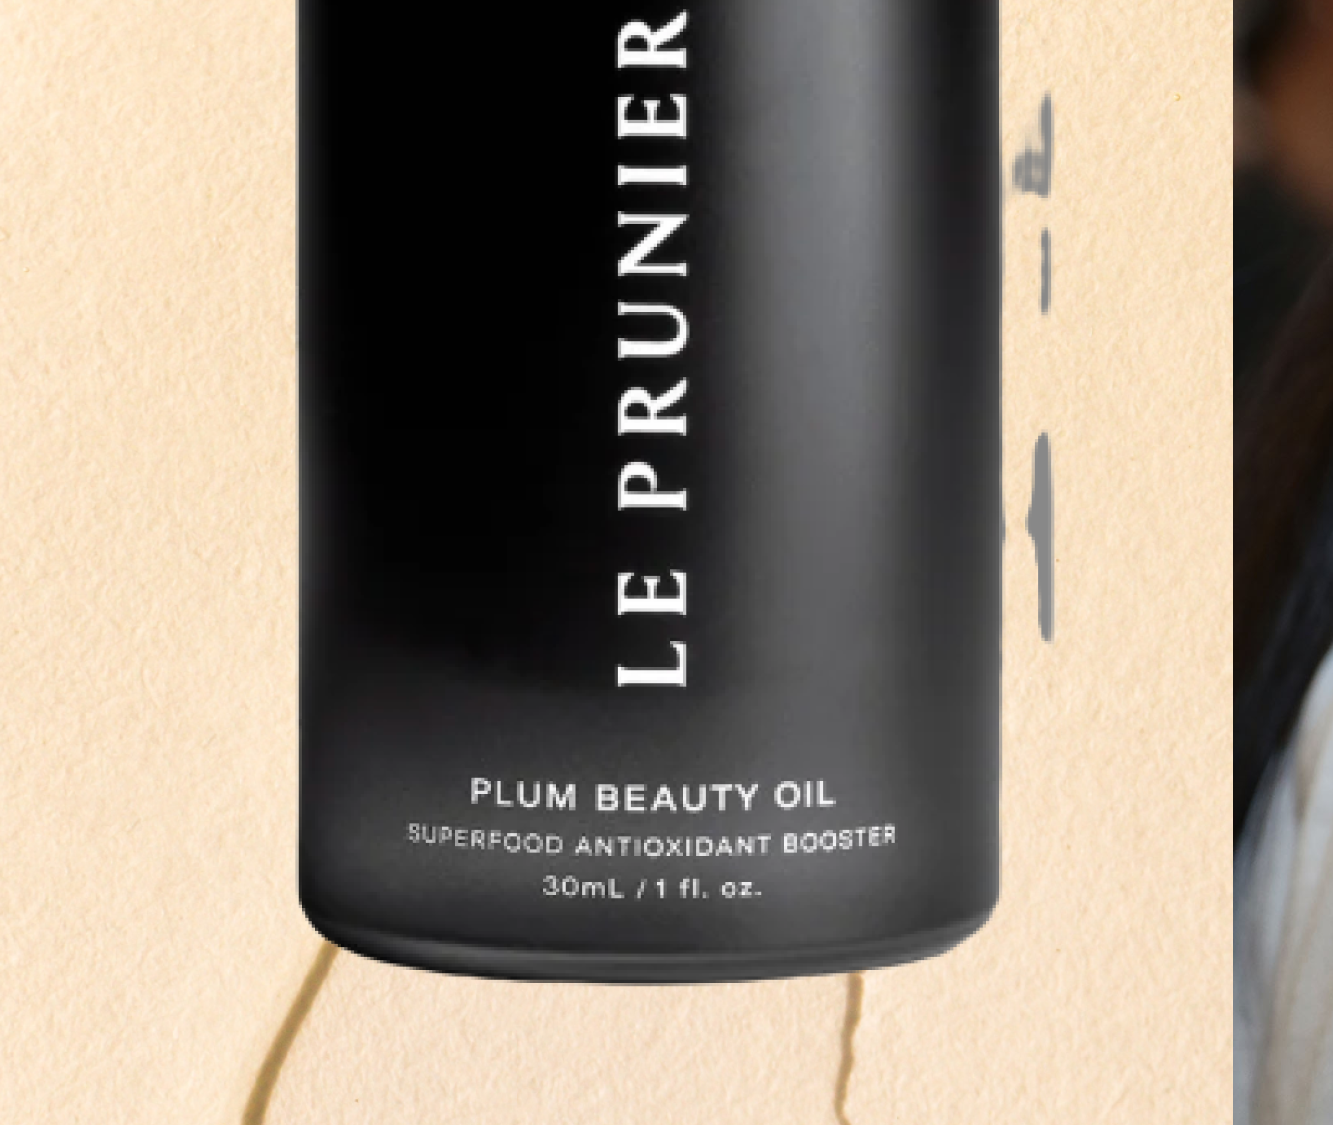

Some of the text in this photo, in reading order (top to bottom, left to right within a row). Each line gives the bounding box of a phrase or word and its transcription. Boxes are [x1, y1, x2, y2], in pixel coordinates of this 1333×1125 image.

[616, 10, 689, 688] LE PRUNIER
[469, 776, 838, 813] PLUM BEAUTY OIL
[407, 822, 897, 858] SUPERFOOD ANTIOXIDANT BOOSTER
[541, 873, 626, 900] 30mL
[655, 877, 666, 900] 1
[678, 877, 708, 900] fl.
[720, 880, 763, 900] oz.
